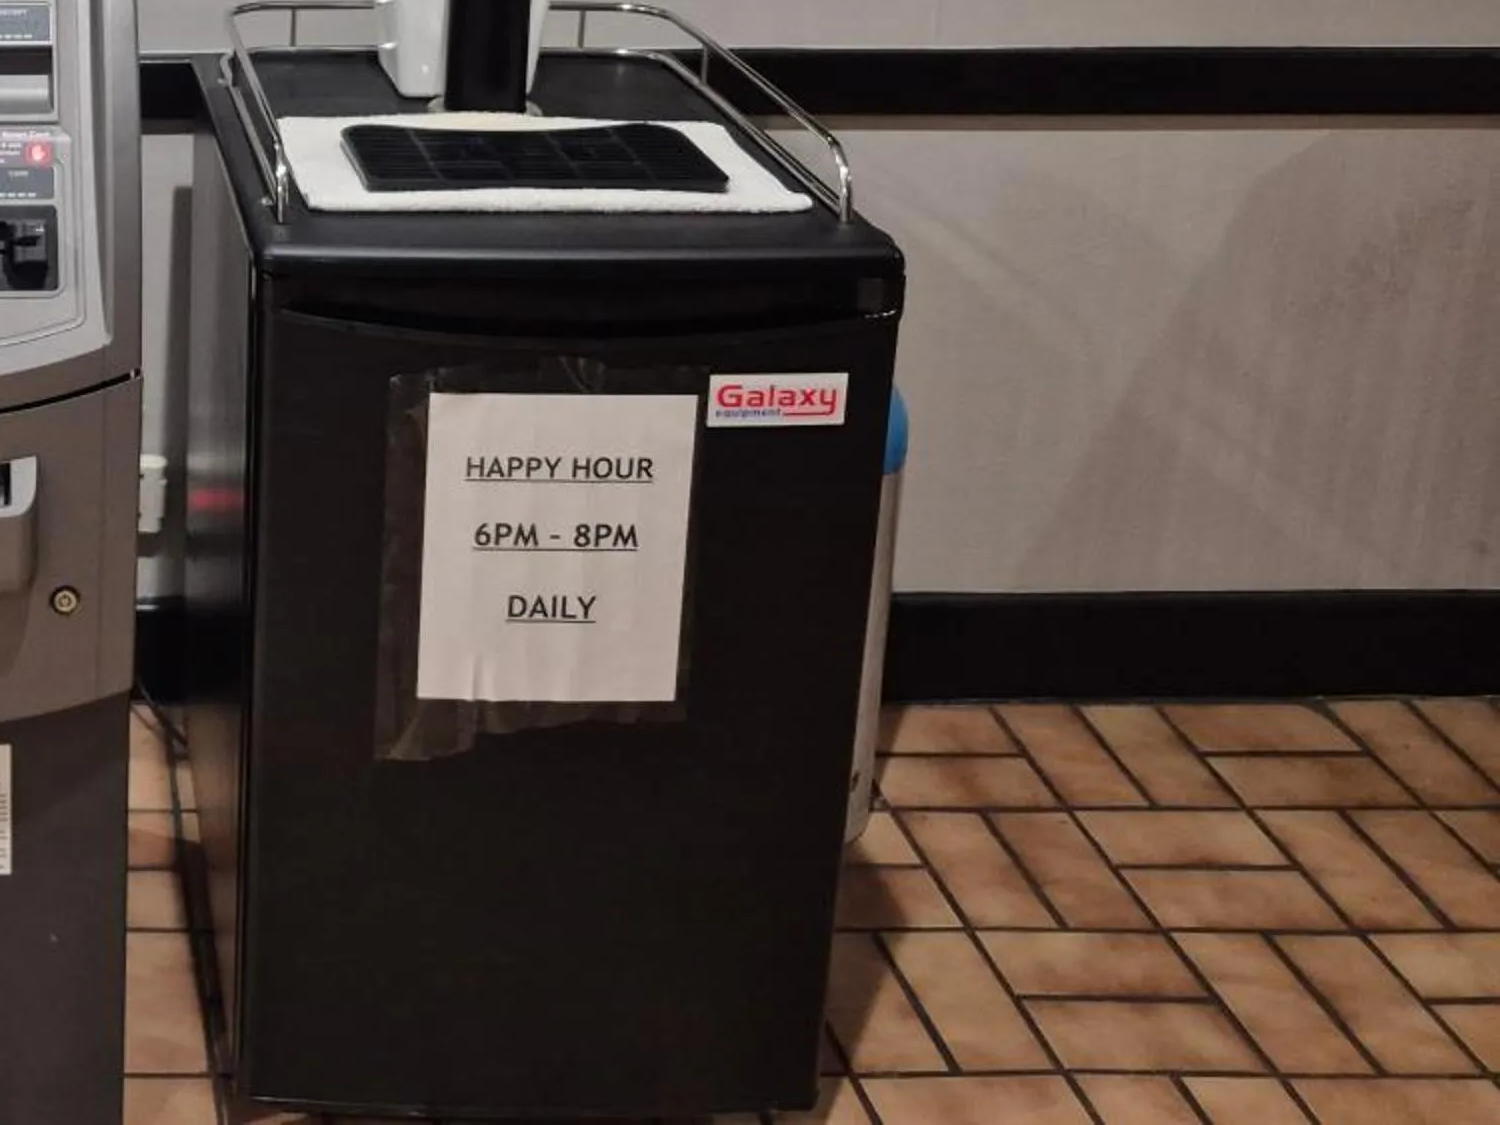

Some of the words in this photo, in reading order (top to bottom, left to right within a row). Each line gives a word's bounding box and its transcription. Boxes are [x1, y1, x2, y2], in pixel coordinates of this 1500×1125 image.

[716, 384, 837, 416] Galaxy
[466, 456, 562, 479] HAPPY
[571, 457, 653, 480] HOUR
[474, 523, 540, 547] 6PM
[573, 524, 639, 548] 8PM
[507, 595, 596, 619] DAILY
